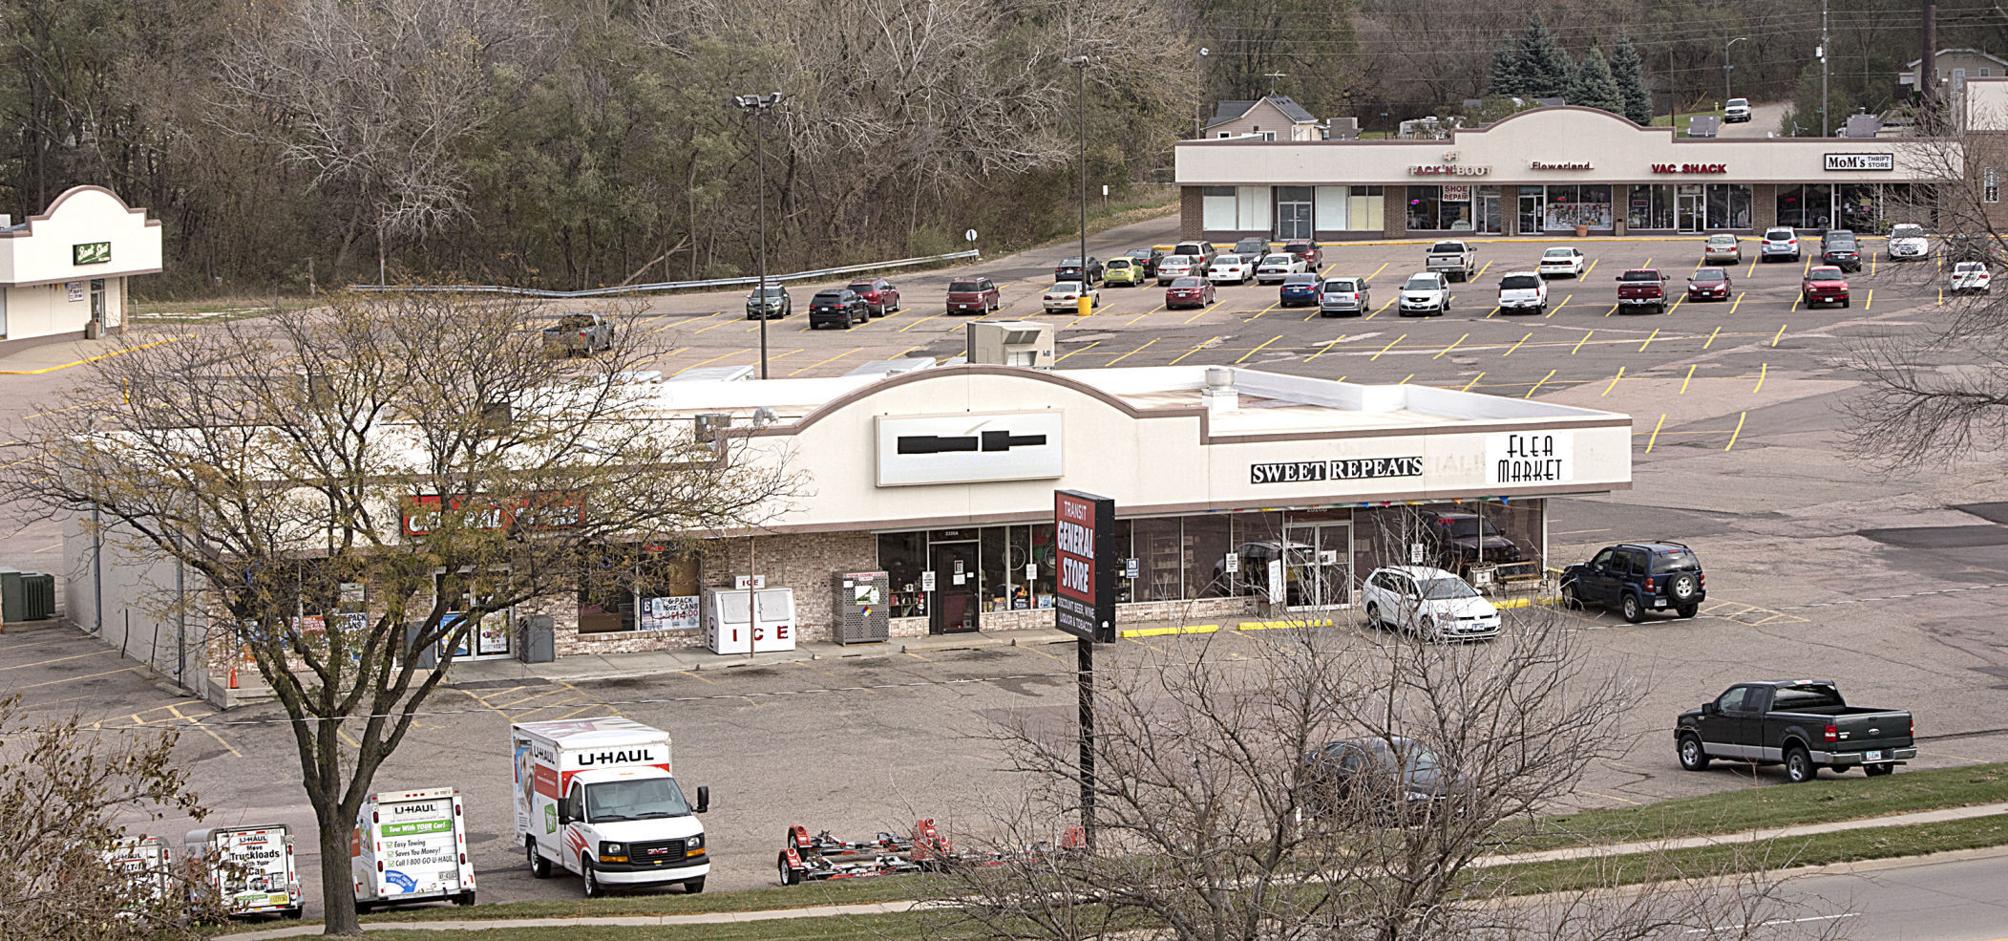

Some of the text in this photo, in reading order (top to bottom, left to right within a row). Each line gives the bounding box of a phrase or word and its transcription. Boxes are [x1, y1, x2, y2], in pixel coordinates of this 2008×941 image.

[1532, 161, 1590, 170] Flowerland
[1828, 156, 1866, 168] MoM's
[1456, 166, 1491, 176] BOOT
[1651, 163, 1727, 174] VAC SHACK
[1444, 184, 1469, 192] SHOE
[1443, 193, 1469, 201] REPAIR
[1507, 433, 1553, 458] FLEA
[1252, 462, 1326, 484] SWEET
[1330, 456, 1424, 480] REPEATS
[1497, 458, 1563, 483] MARKET
[1063, 500, 1087, 521] TRANSIT
[1057, 519, 1094, 560] GENERAL
[1063, 557, 1089, 593] STORE
[732, 625, 789, 642] ICE
[534, 745, 555, 764] U-HAUL
[578, 749, 654, 766] U-HAUL
[395, 804, 436, 814] U-HAUL
[239, 835, 268, 843] U-HAUL
[394, 839, 426, 848] Easy Towing
[231, 850, 280, 861] Truckloads
[394, 849, 410, 857] Saves
[421, 846, 441, 856] Money!
